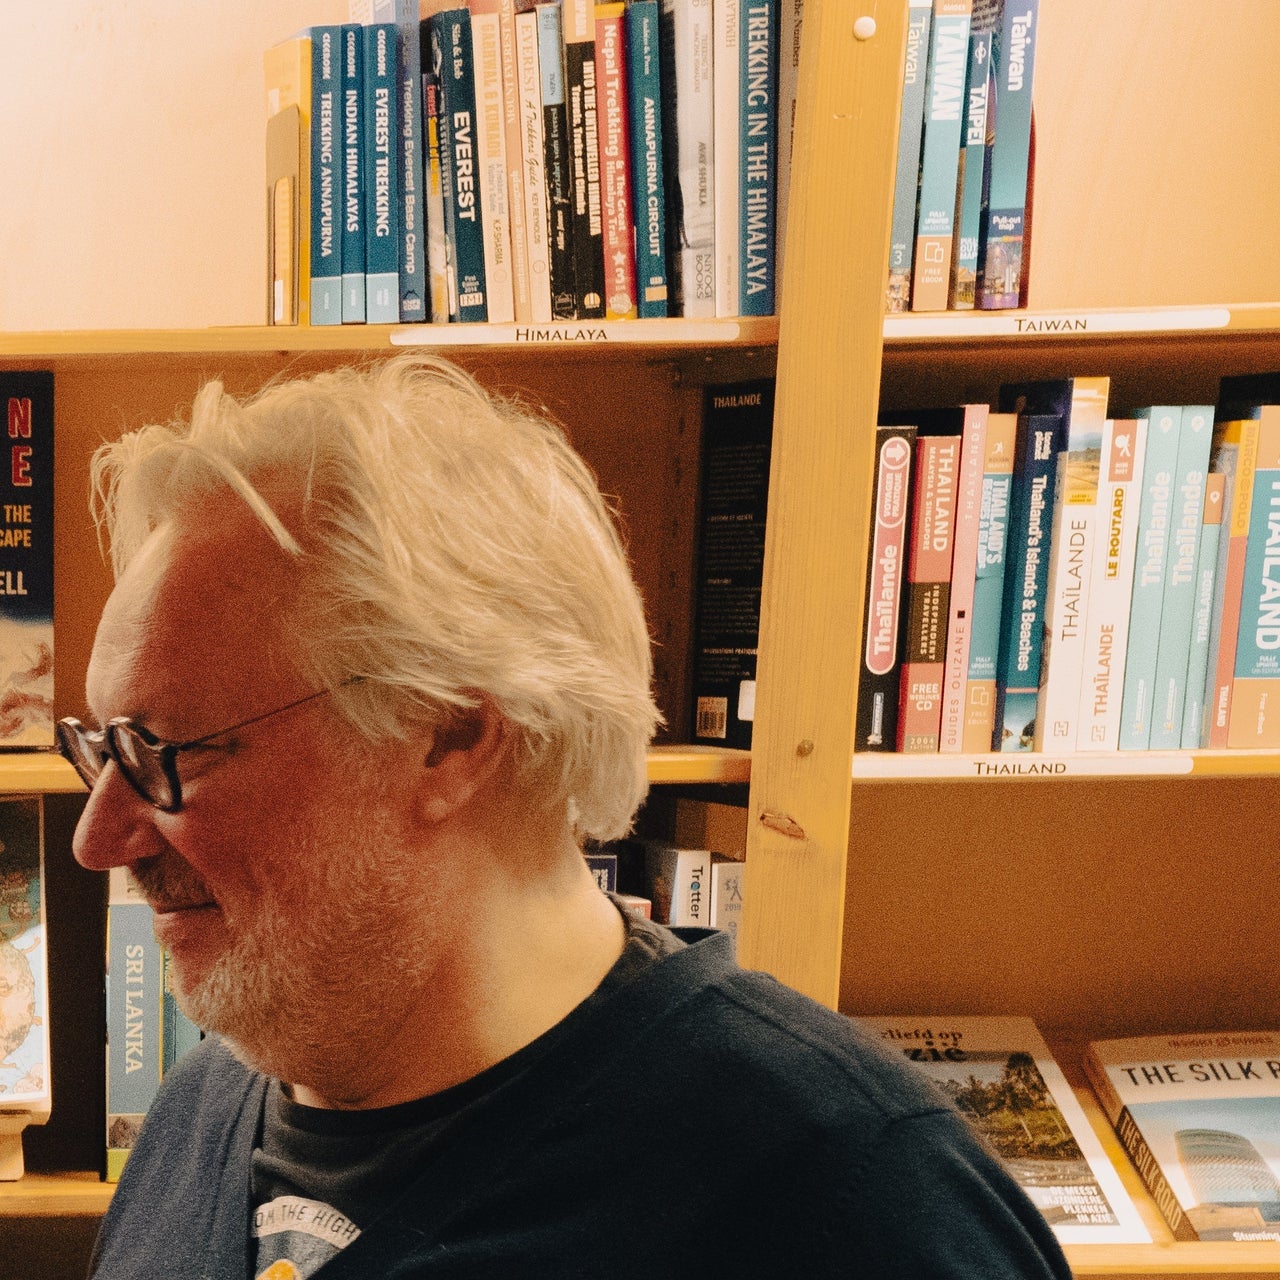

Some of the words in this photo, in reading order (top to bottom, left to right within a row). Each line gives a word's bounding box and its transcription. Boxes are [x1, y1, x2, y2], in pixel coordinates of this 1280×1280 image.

[604, 24, 618, 75] Nepal
[747, 4, 769, 105] TREKKING
[931, 21, 967, 120] TAIWAN
[1008, 11, 1031, 91] Taiwan
[321, 92, 332, 162] TREKKING
[345, 90, 357, 144] INDIAN
[376, 89, 388, 154] EVEREST
[403, 79, 413, 137] Trekking
[606, 80, 621, 157] Trekking
[749, 112, 767, 138] IN
[967, 83, 987, 145] TAIPEI
[404, 140, 414, 191] Everest
[454, 112, 475, 221] EVEREST
[644, 97, 657, 194] ANNAPURNA
[747, 142, 767, 181] THE
[321, 166, 332, 257] ANNAPURNA
[345, 148, 358, 232] HIMALAYAS
[376, 157, 390, 237] TREKKING
[405, 195, 415, 230] Base
[405, 233, 416, 274] Camp
[648, 199, 660, 256] CIRCUIT
[747, 188, 767, 295] HIMALAYA
[515, 329, 607, 341] HIMALAYA
[1015, 319, 1088, 332] TAIWAN
[4, 505, 31, 523] THE
[933, 445, 953, 551] THAILAND
[1173, 471, 1203, 585] Thaïlande
[874, 545, 897, 655] Thaïlande
[1062, 520, 1087, 641] THAÏLANDE
[912, 683, 939, 694] FREE
[1094, 624, 1114, 717] THAÏLANDE
[916, 701, 932, 711] CD
[973, 762, 1066, 775] THAILAND
[126, 945, 144, 988] SRI
[125, 990, 144, 1074] LANKA
[1122, 1067, 1184, 1087] THE
[1189, 1062, 1258, 1082] SILK
[282, 1205, 308, 1220] THE
[313, 1208, 356, 1240] HIGH
